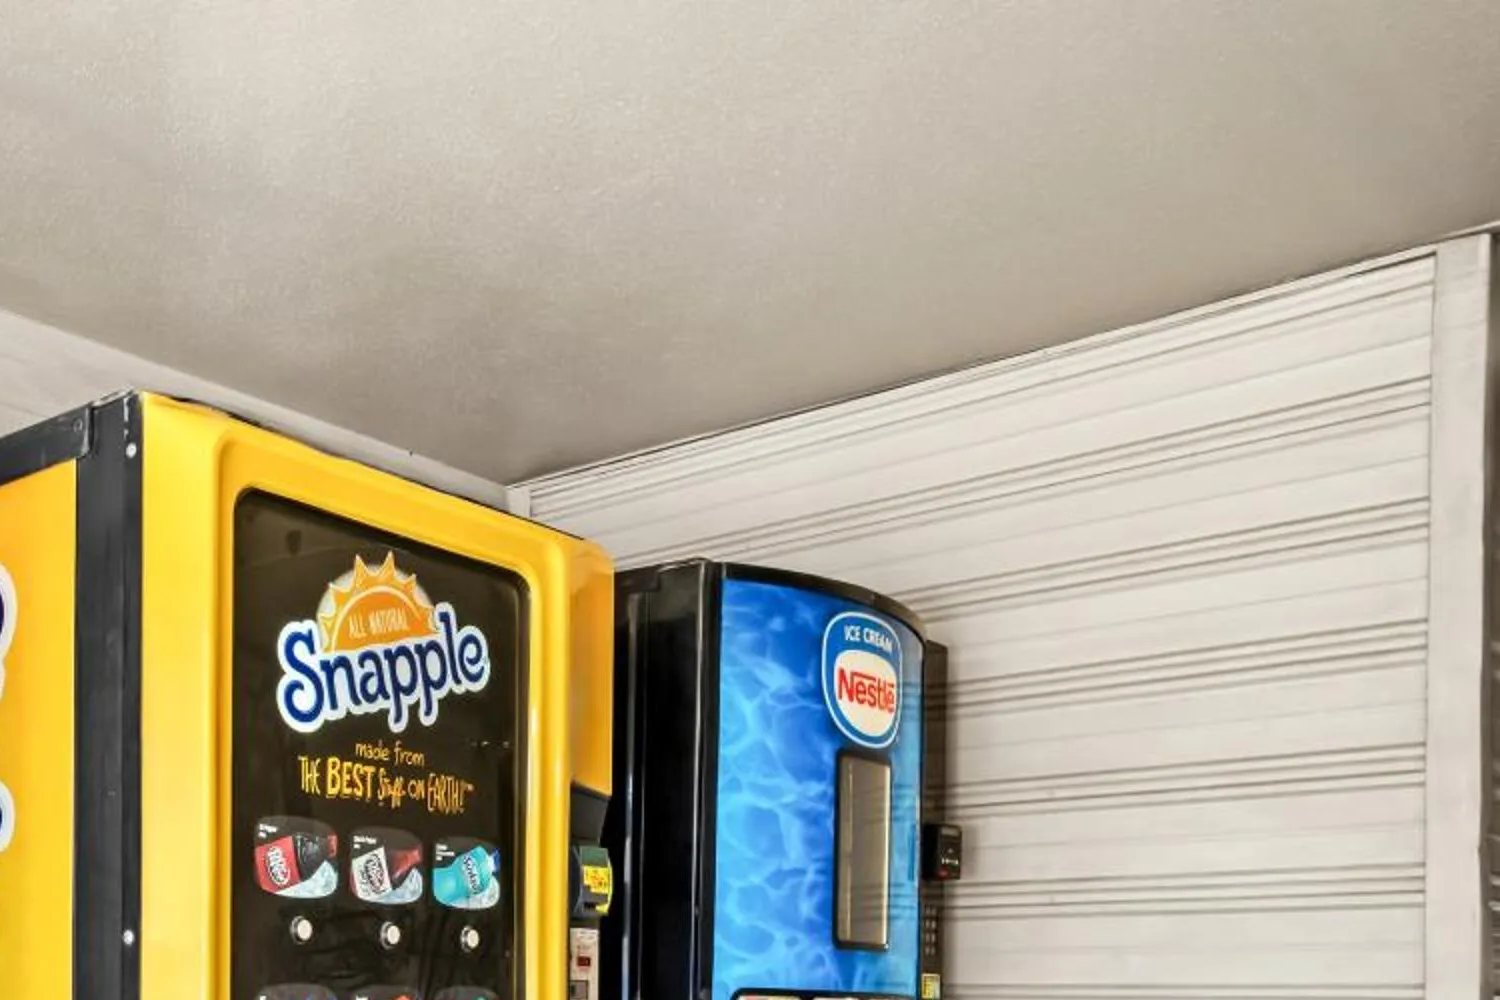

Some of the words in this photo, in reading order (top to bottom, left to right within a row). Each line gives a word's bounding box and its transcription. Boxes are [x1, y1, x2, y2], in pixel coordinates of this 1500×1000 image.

[844, 624, 861, 642] ICE
[862, 627, 893, 654] CREAM
[282, 608, 486, 726] Snapple
[355, 740, 389, 759] made
[393, 740, 425, 767] from
[298, 756, 322, 795] THE
[326, 757, 377, 799] BEST
